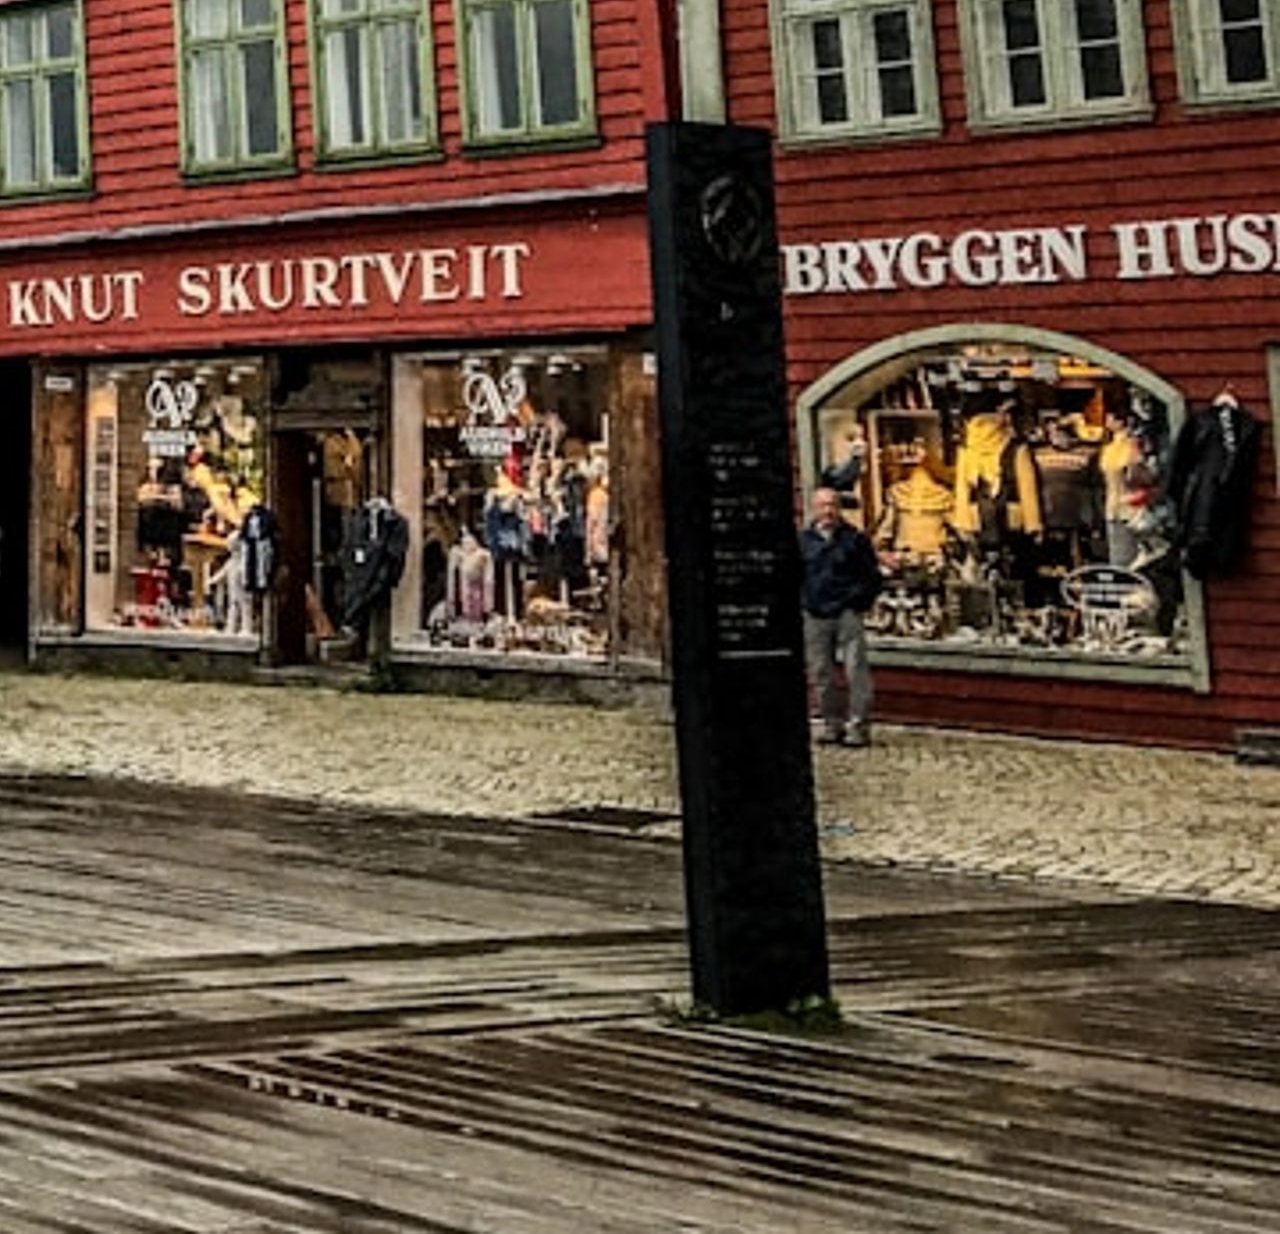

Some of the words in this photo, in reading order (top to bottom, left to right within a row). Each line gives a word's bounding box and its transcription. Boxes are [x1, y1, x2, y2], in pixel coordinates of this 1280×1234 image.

[8, 271, 143, 326] KNUT
[177, 242, 531, 315] SKURTVEIT
[781, 225, 1087, 294] BRYGGEN
[1111, 213, 1280, 280] HUS
